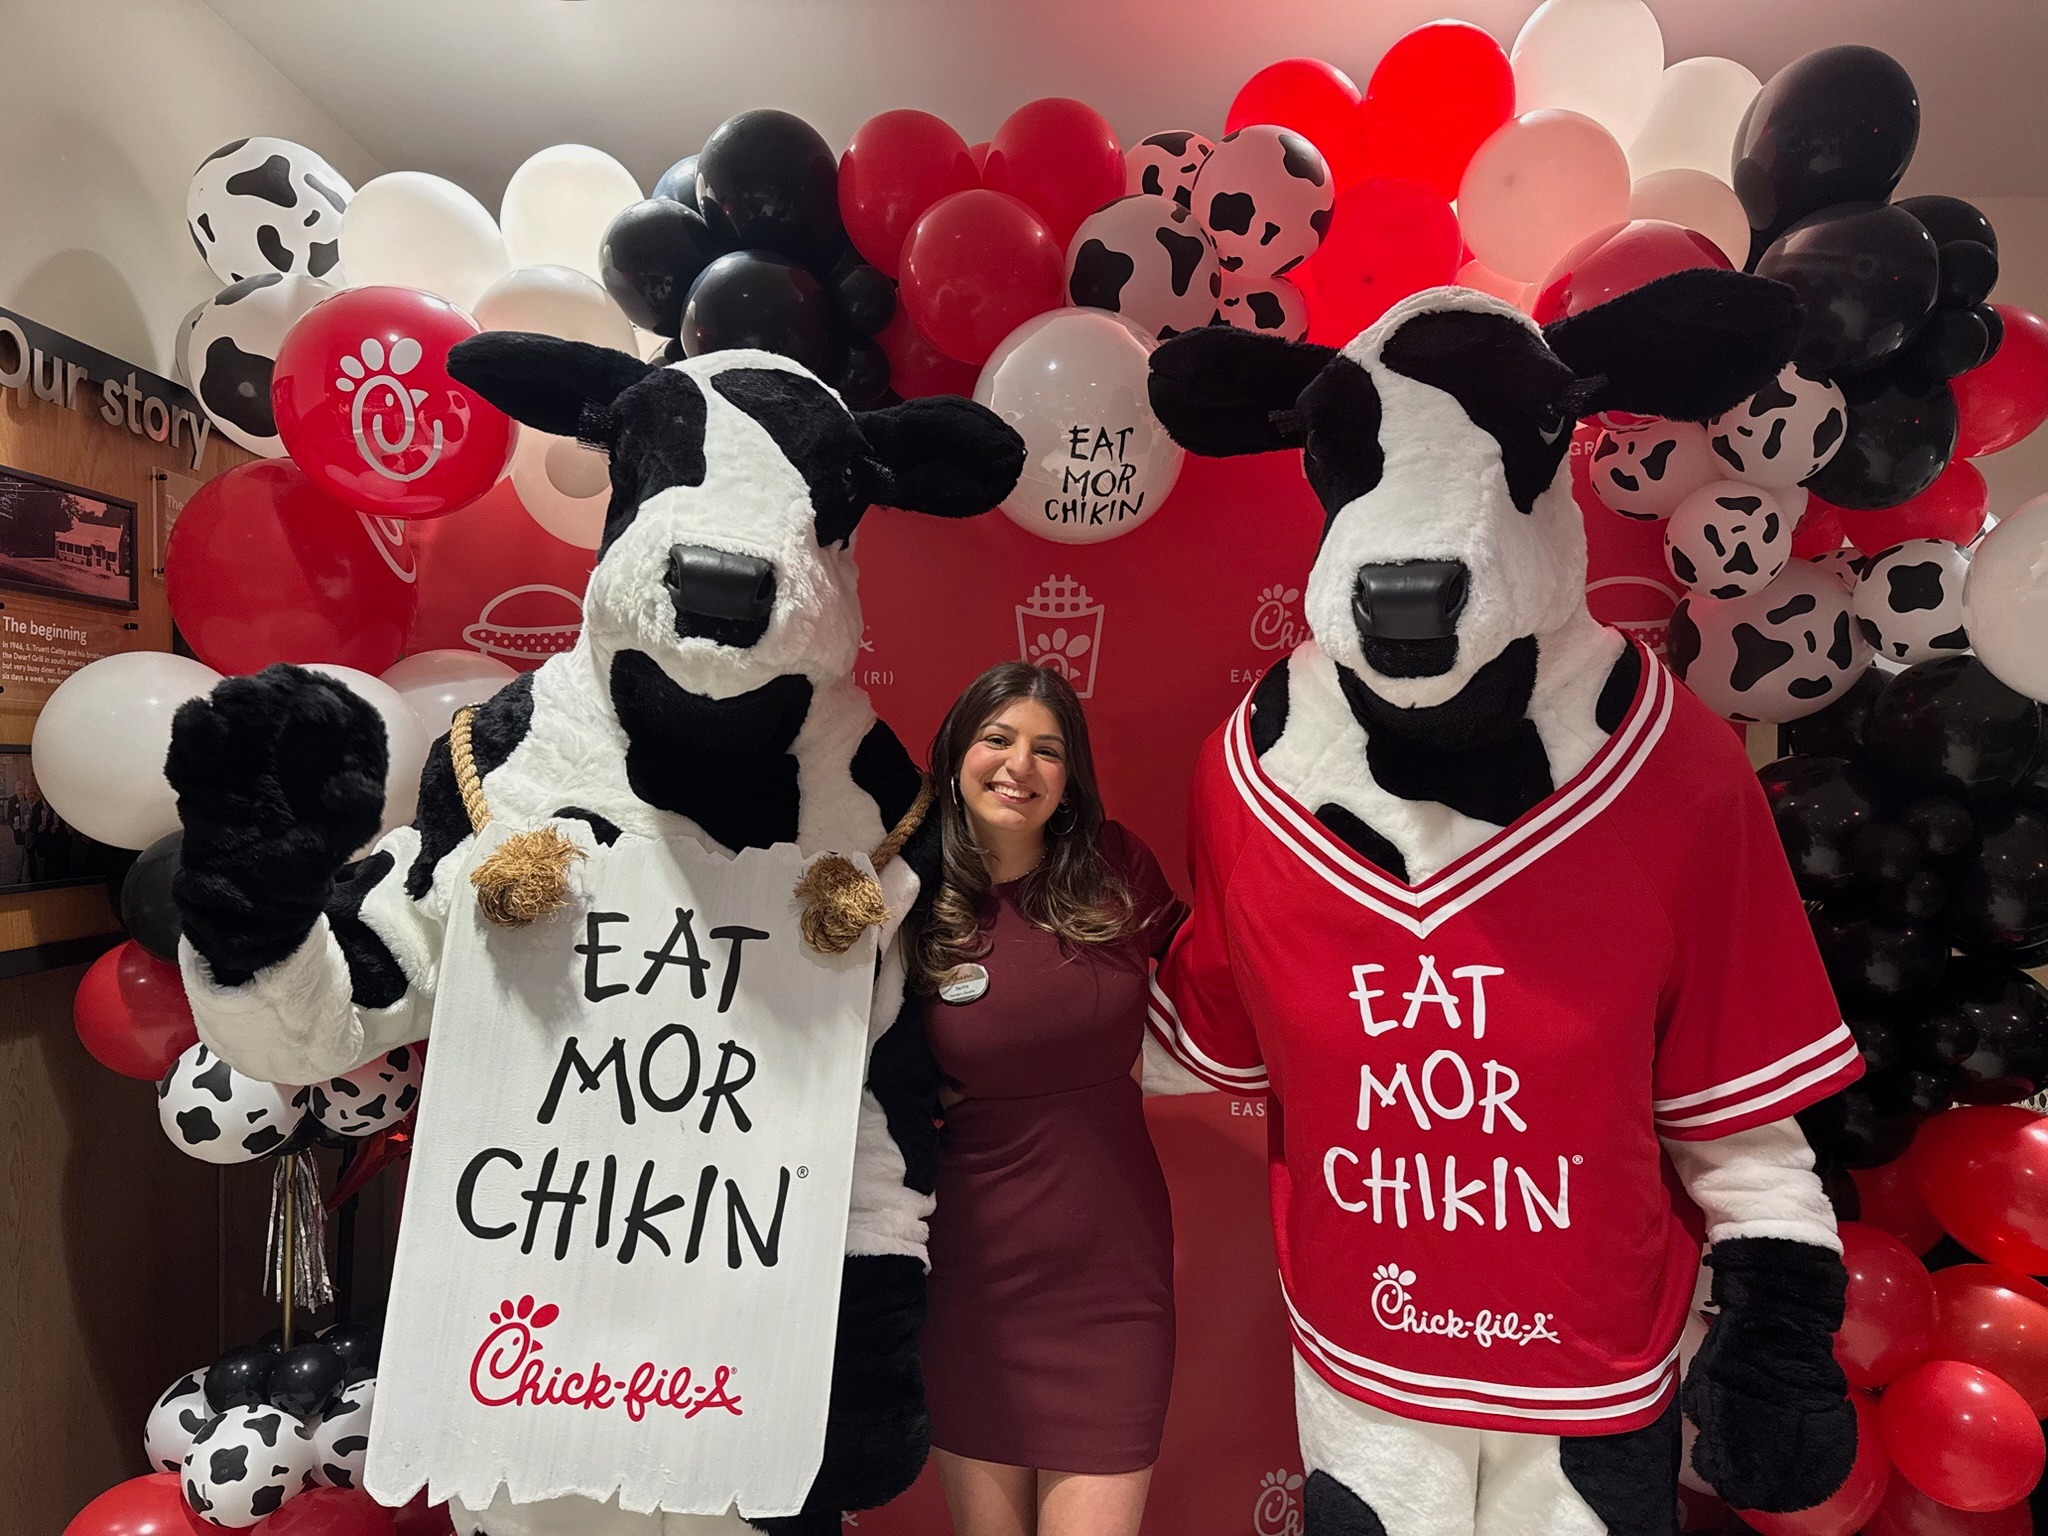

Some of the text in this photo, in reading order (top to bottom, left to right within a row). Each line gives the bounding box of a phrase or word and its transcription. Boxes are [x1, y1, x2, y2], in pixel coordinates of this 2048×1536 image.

[0, 316, 211, 471] Our story
[1069, 425, 1134, 462] EAT
[1062, 463, 1137, 499] MOR
[1045, 492, 1145, 526] CHIKIN
[3, 615, 87, 645] The beginning
[2, 651, 12, 659] the
[13, 652, 31, 661] Dwarf
[2, 661, 13, 669] but
[13, 664, 26, 673] very
[27, 664, 40, 674] busy
[10, 673, 24, 682] days
[864, 670, 894, 685] (RI)
[574, 907, 770, 1013] EAT
[1348, 954, 1505, 1039] EAT
[536, 1023, 756, 1133] MOR
[1356, 1049, 1528, 1134] MOR
